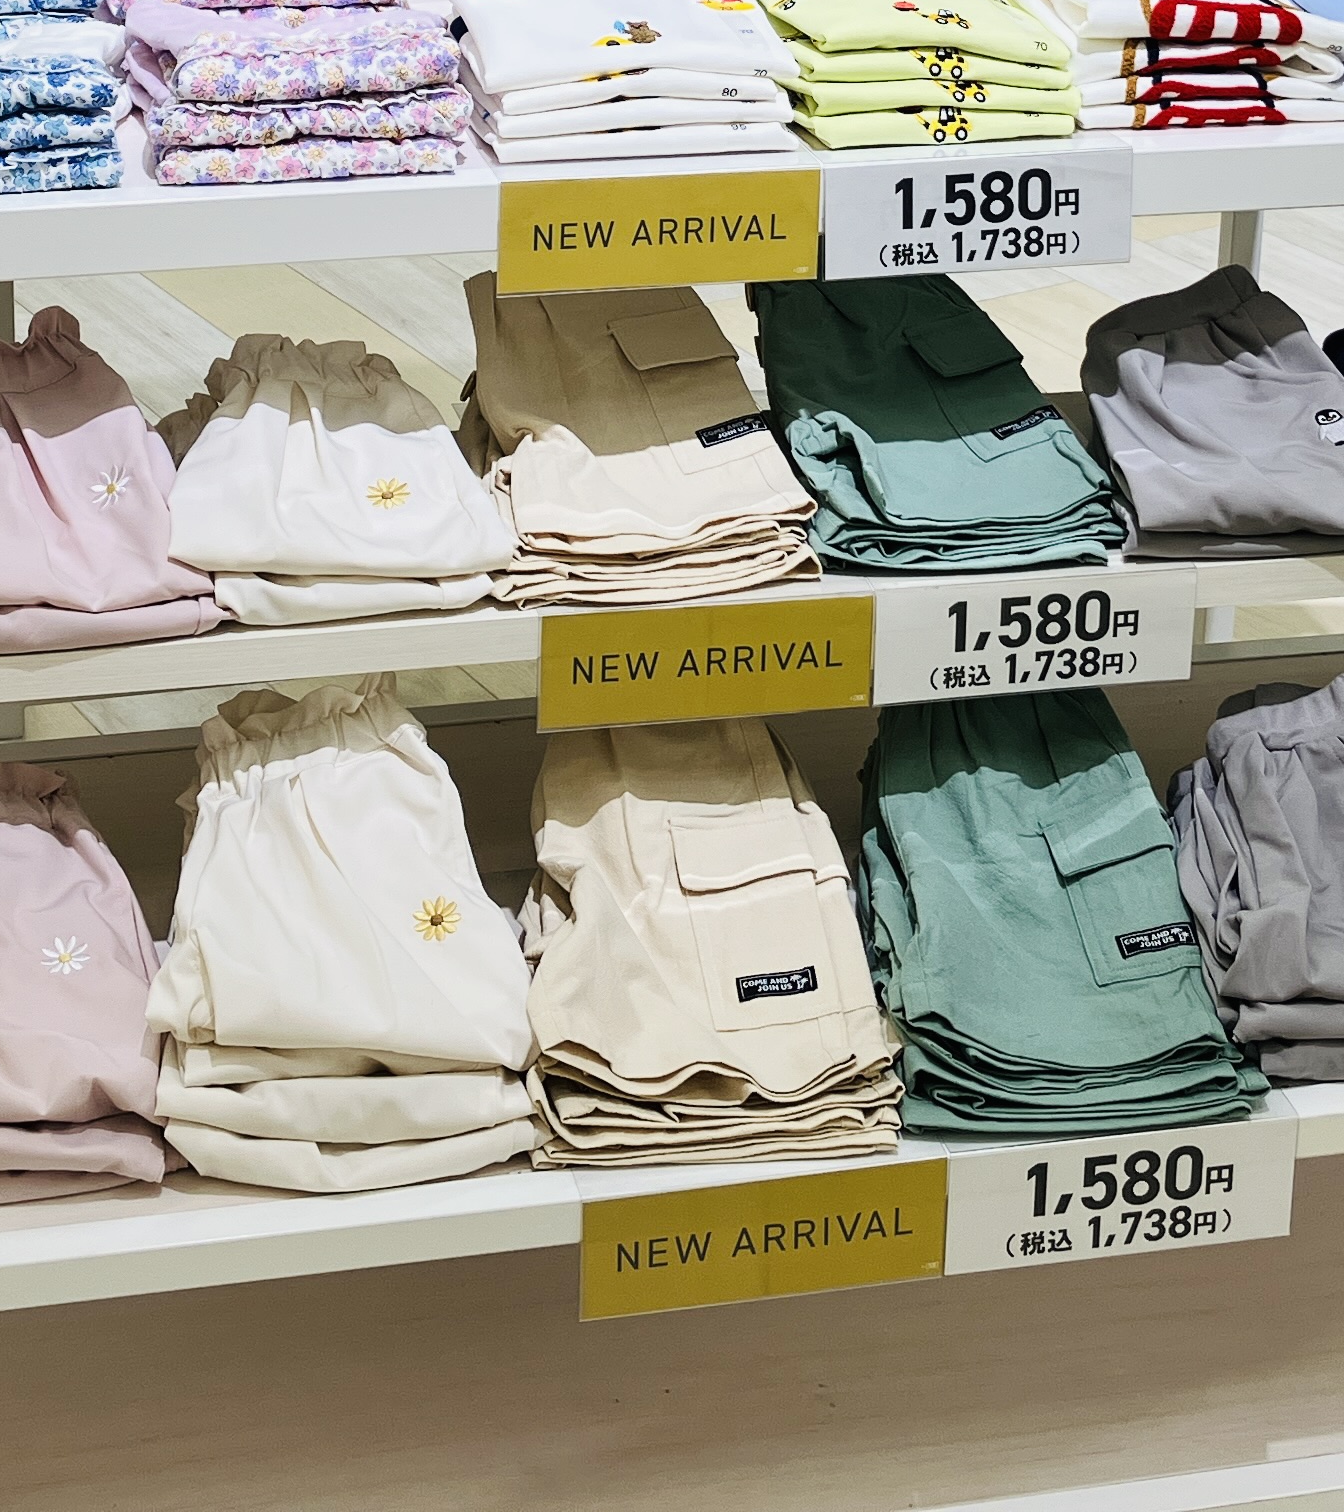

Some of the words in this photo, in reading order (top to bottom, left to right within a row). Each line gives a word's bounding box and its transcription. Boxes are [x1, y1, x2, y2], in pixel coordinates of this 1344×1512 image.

[1034, 41, 1048, 51] 70
[721, 87, 738, 97] 80
[894, 167, 1081, 230] 1,580円
[532, 219, 615, 252] NEW
[631, 213, 787, 247] ARRIVAL
[947, 590, 1139, 654] 1,580円
[571, 649, 661, 686] NEW
[677, 639, 843, 678] ARRIVAL
[1124, 935, 1149, 945] COME
[1151, 930, 1169, 941] AND
[1140, 940, 1161, 948] JOIN
[1162, 935, 1175, 944] US
[742, 978, 767, 988] COME
[757, 984, 779, 992] JOIN
[780, 983, 793, 991] US
[1026, 1144, 1234, 1219] 1,580円
[616, 1231, 710, 1274] NEW
[731, 1205, 915, 1259] ARRIVAL
